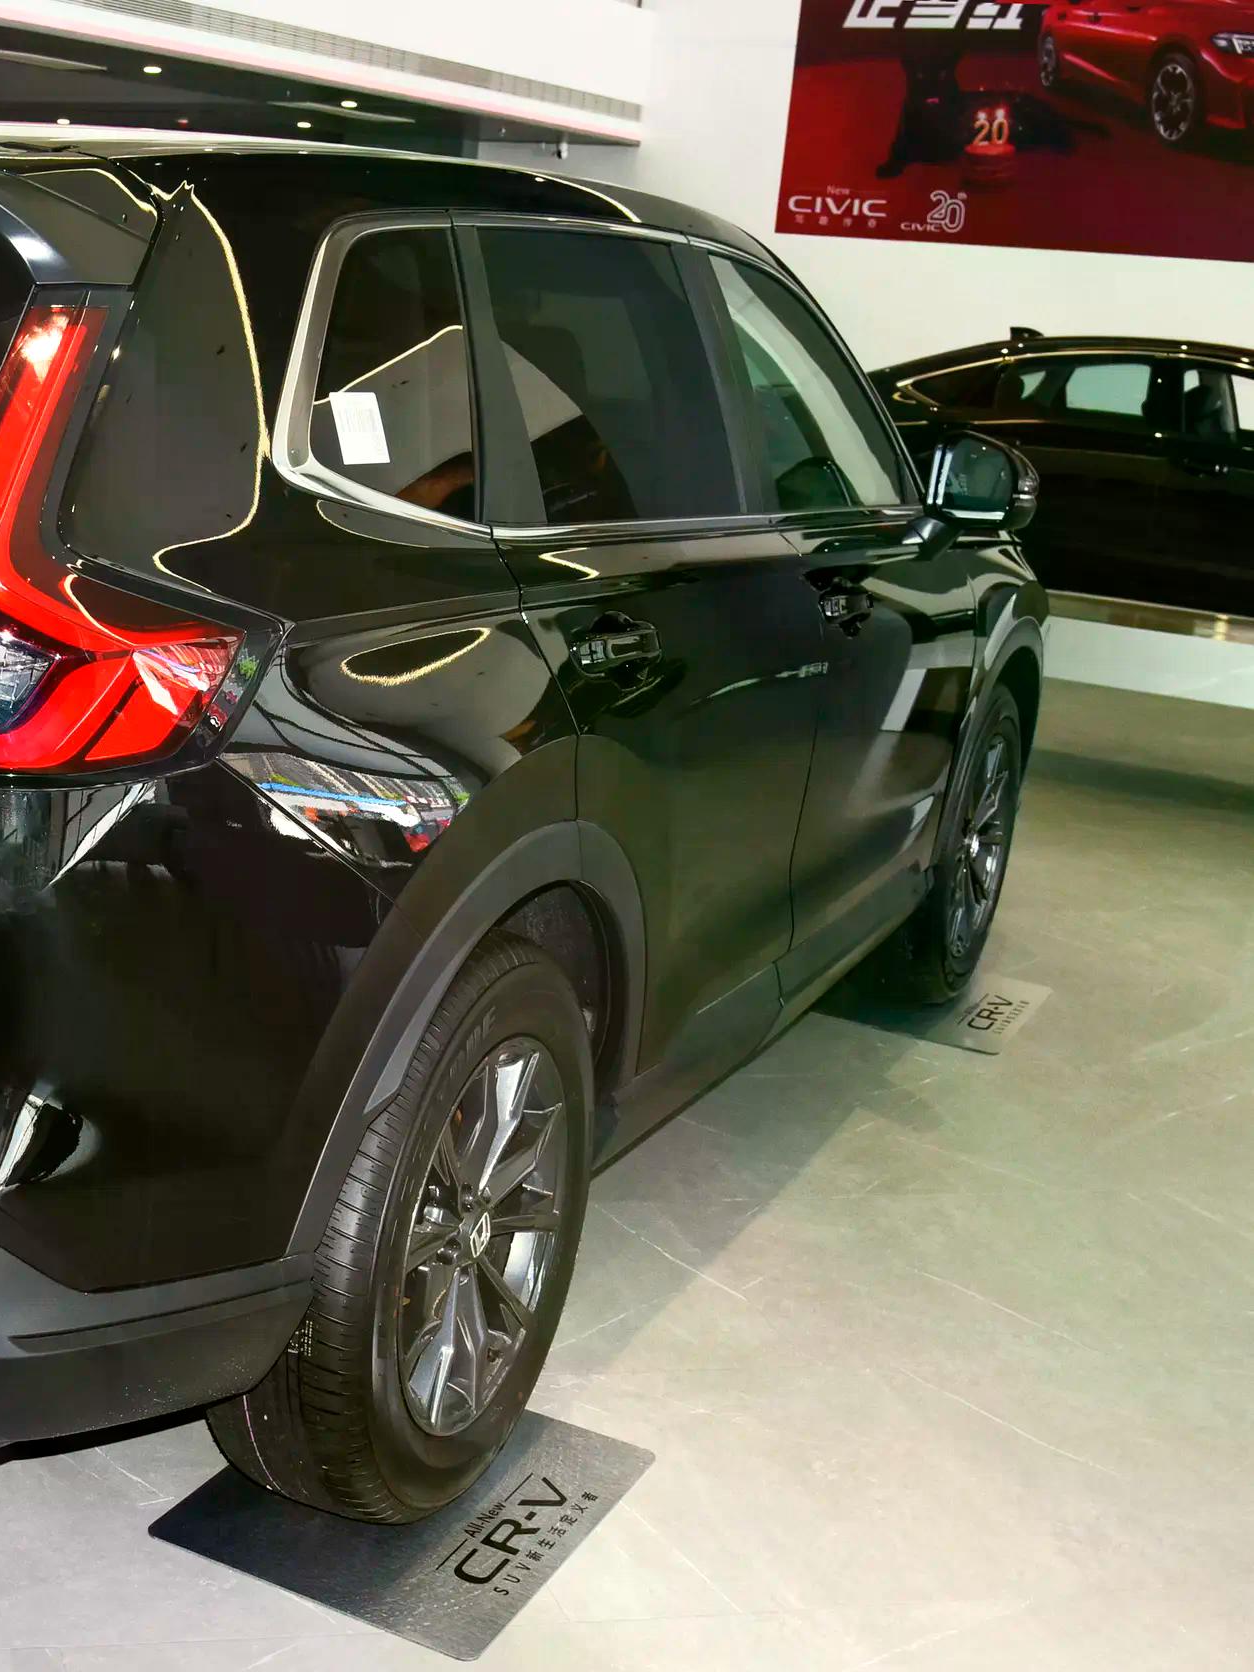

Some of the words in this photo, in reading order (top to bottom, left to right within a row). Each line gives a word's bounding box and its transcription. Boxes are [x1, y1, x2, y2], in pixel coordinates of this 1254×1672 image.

[973, 119, 1010, 146] 20
[826, 185, 850, 196] New
[788, 195, 888, 217] CIVIC
[899, 221, 942, 233] CIVIC
[967, 994, 1013, 1031] CR-V
[453, 1476, 568, 1585] CR-V
[463, 1500, 508, 1539] All-New
